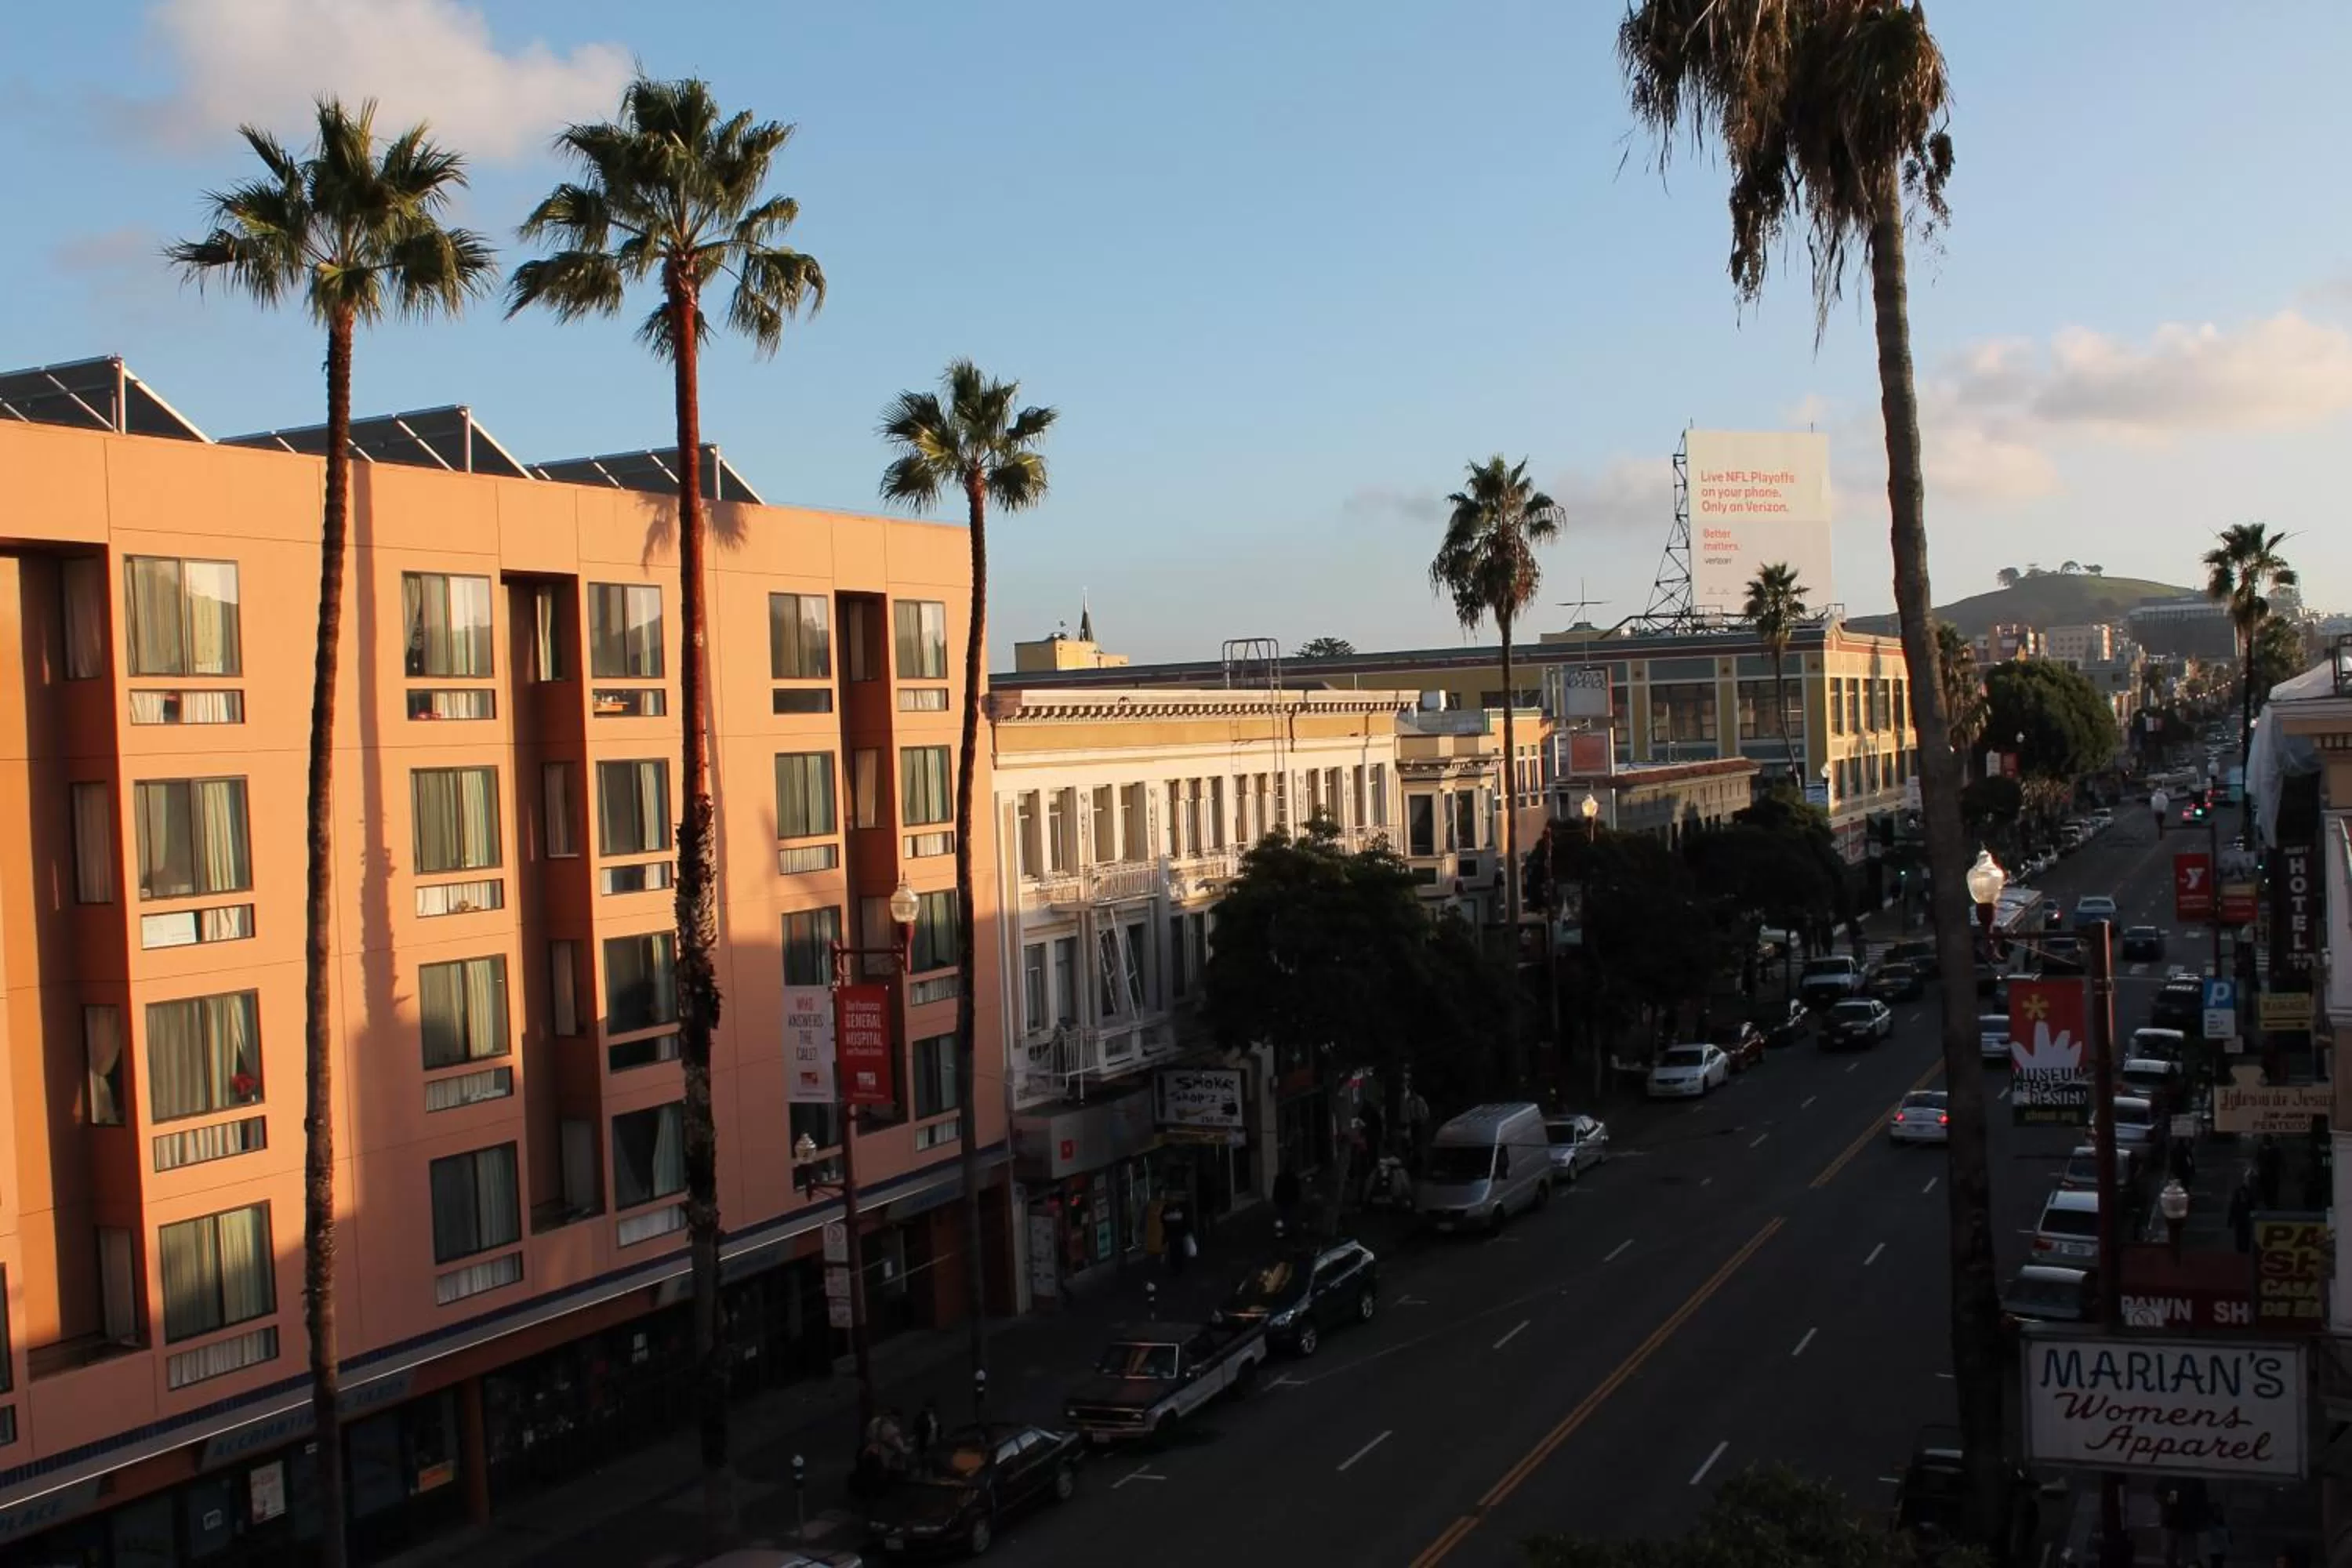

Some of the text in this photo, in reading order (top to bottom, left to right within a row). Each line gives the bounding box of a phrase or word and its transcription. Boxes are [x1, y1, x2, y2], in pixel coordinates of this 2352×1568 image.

[1700, 470, 1795, 484] Live NFL Playoffs
[1701, 486, 1782, 499] on your phone.
[1702, 500, 1789, 513] Only on Verizon.
[1703, 528, 1731, 539] Better
[1704, 542, 1740, 551] matters.
[2288, 856, 2307, 950] HOTEL
[788, 1014, 824, 1027] ANSWERS
[844, 1012, 882, 1029] GENERAL
[844, 1031, 884, 1047] HOSPITAL
[2040, 1348, 2285, 1399] MARIAN'S
[2054, 1392, 2253, 1428] Womens
[2085, 1425, 2272, 1463] Apparel
